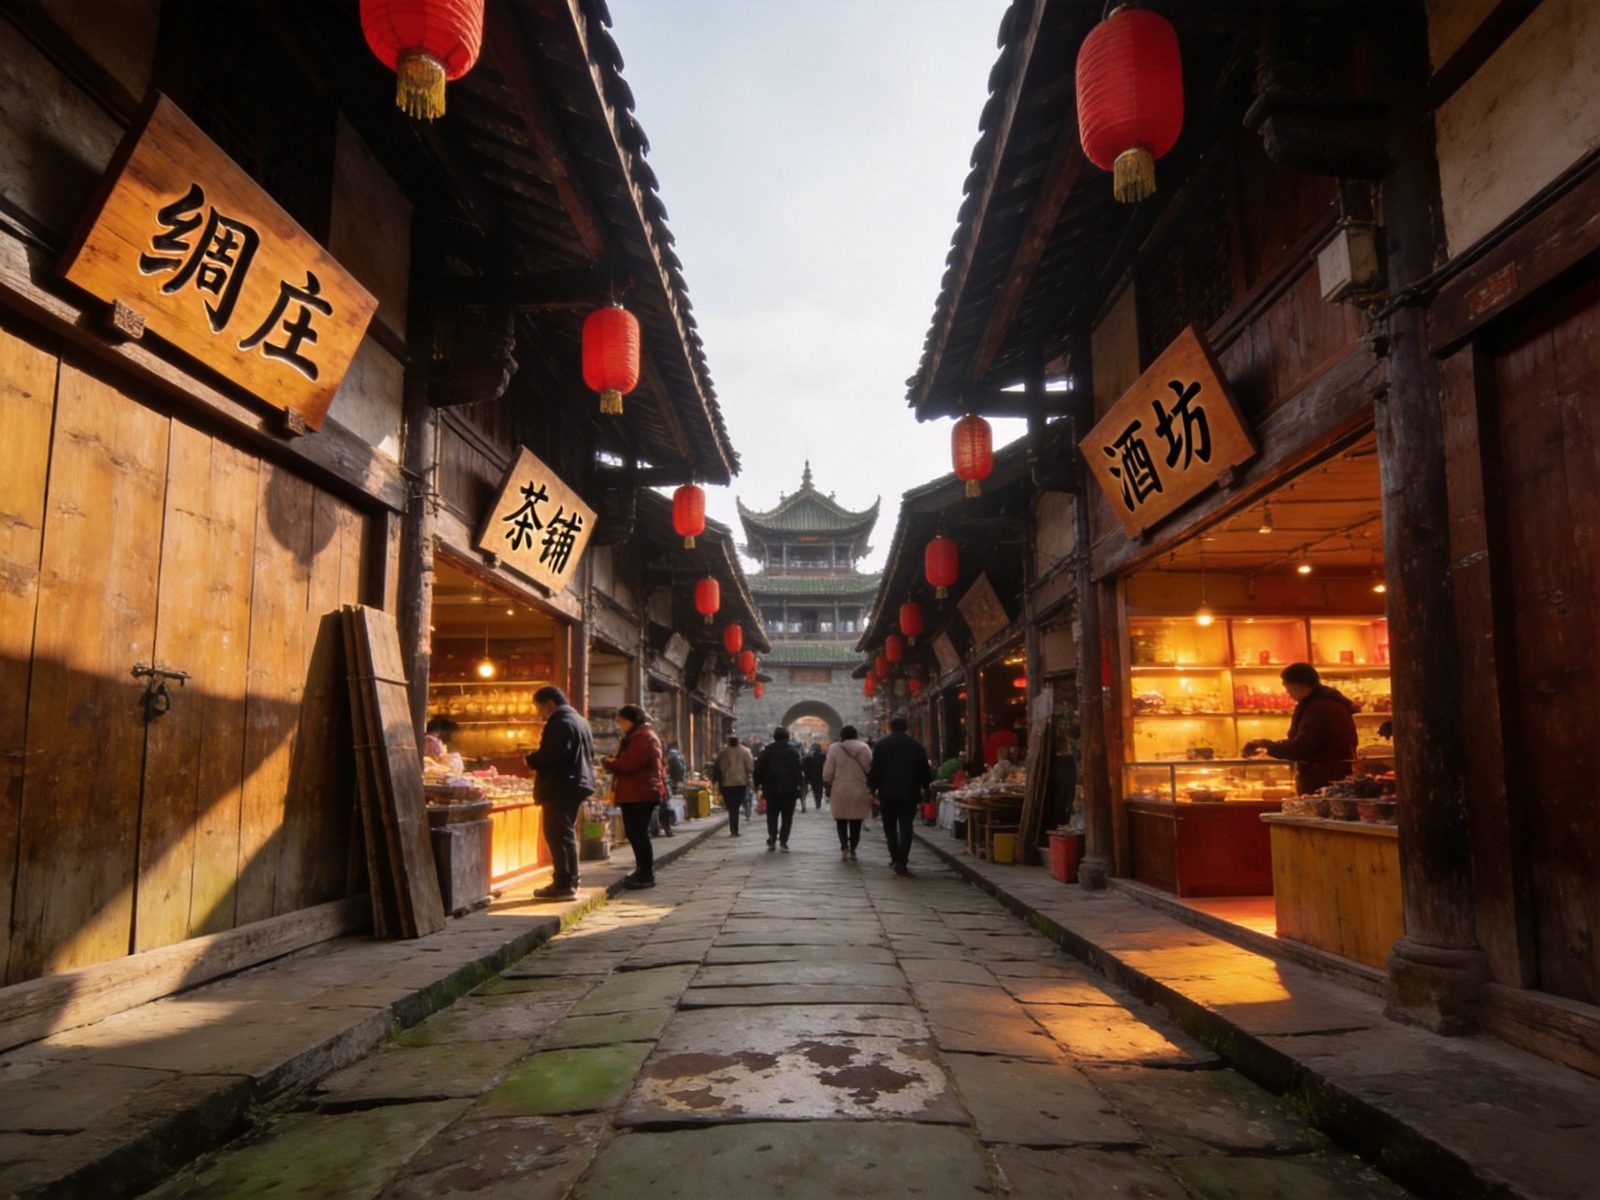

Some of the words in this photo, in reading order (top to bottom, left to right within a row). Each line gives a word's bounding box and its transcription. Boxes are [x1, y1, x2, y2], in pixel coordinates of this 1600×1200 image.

[139, 183, 333, 381] 绸庄
[1103, 380, 1211, 512] 酒坊
[502, 481, 583, 574] 茶铺
